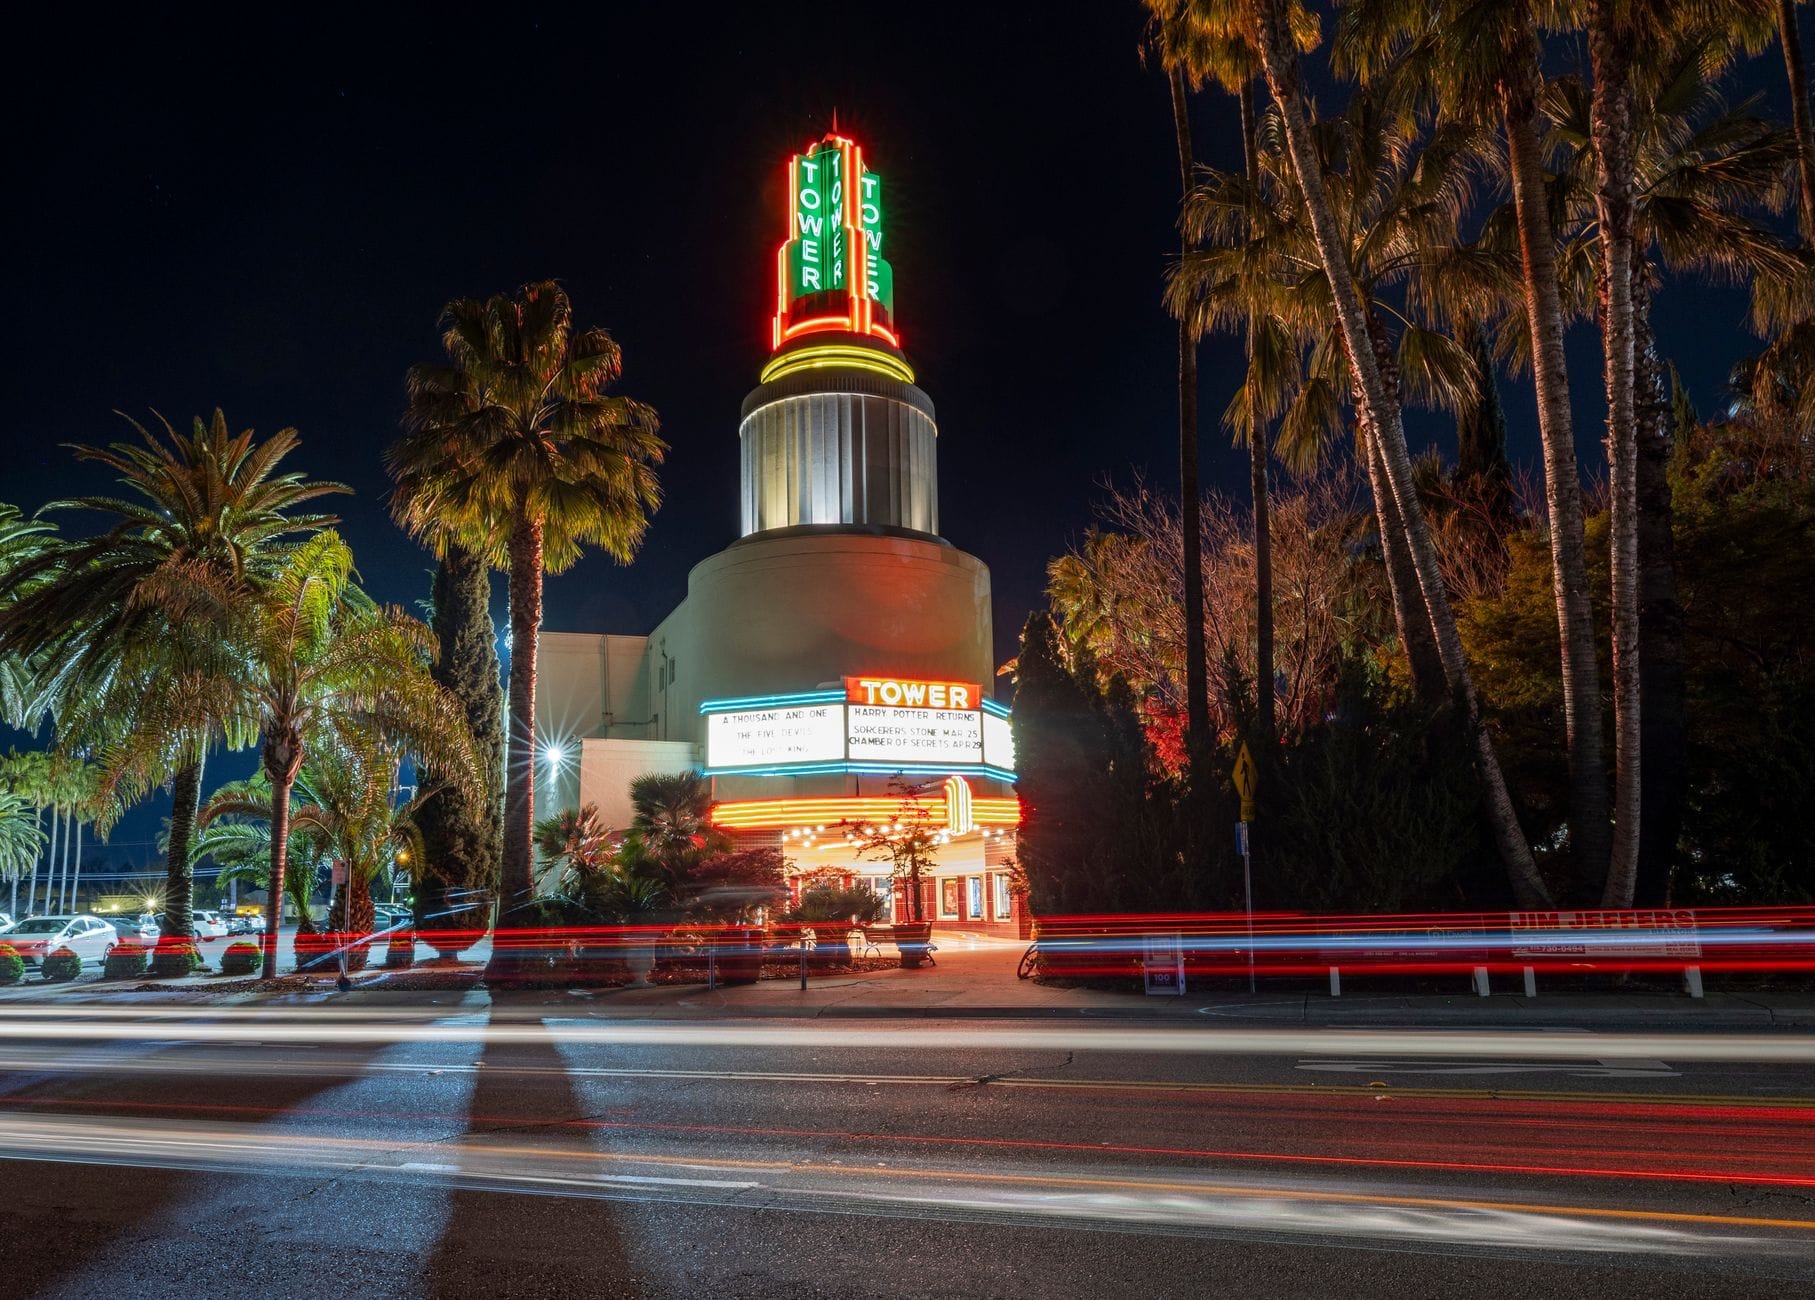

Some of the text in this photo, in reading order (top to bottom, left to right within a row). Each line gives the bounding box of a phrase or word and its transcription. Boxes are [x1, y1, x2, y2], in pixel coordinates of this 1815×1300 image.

[798, 161, 822, 289] TOWER
[831, 152, 842, 285] TOWER
[861, 177, 881, 300] TOWER
[859, 681, 969, 709] TOWER
[723, 708, 828, 724] A THOUSAND AND ONE
[855, 708, 975, 721] HARRY POTTER RETURNS
[737, 731, 751, 740] THE
[853, 726, 978, 738] SORCERERS STONE MAR 25
[849, 736, 982, 750] CHAMBER OF SECRETS APR 29
[1512, 910, 1695, 929] JIM JEFFERS
